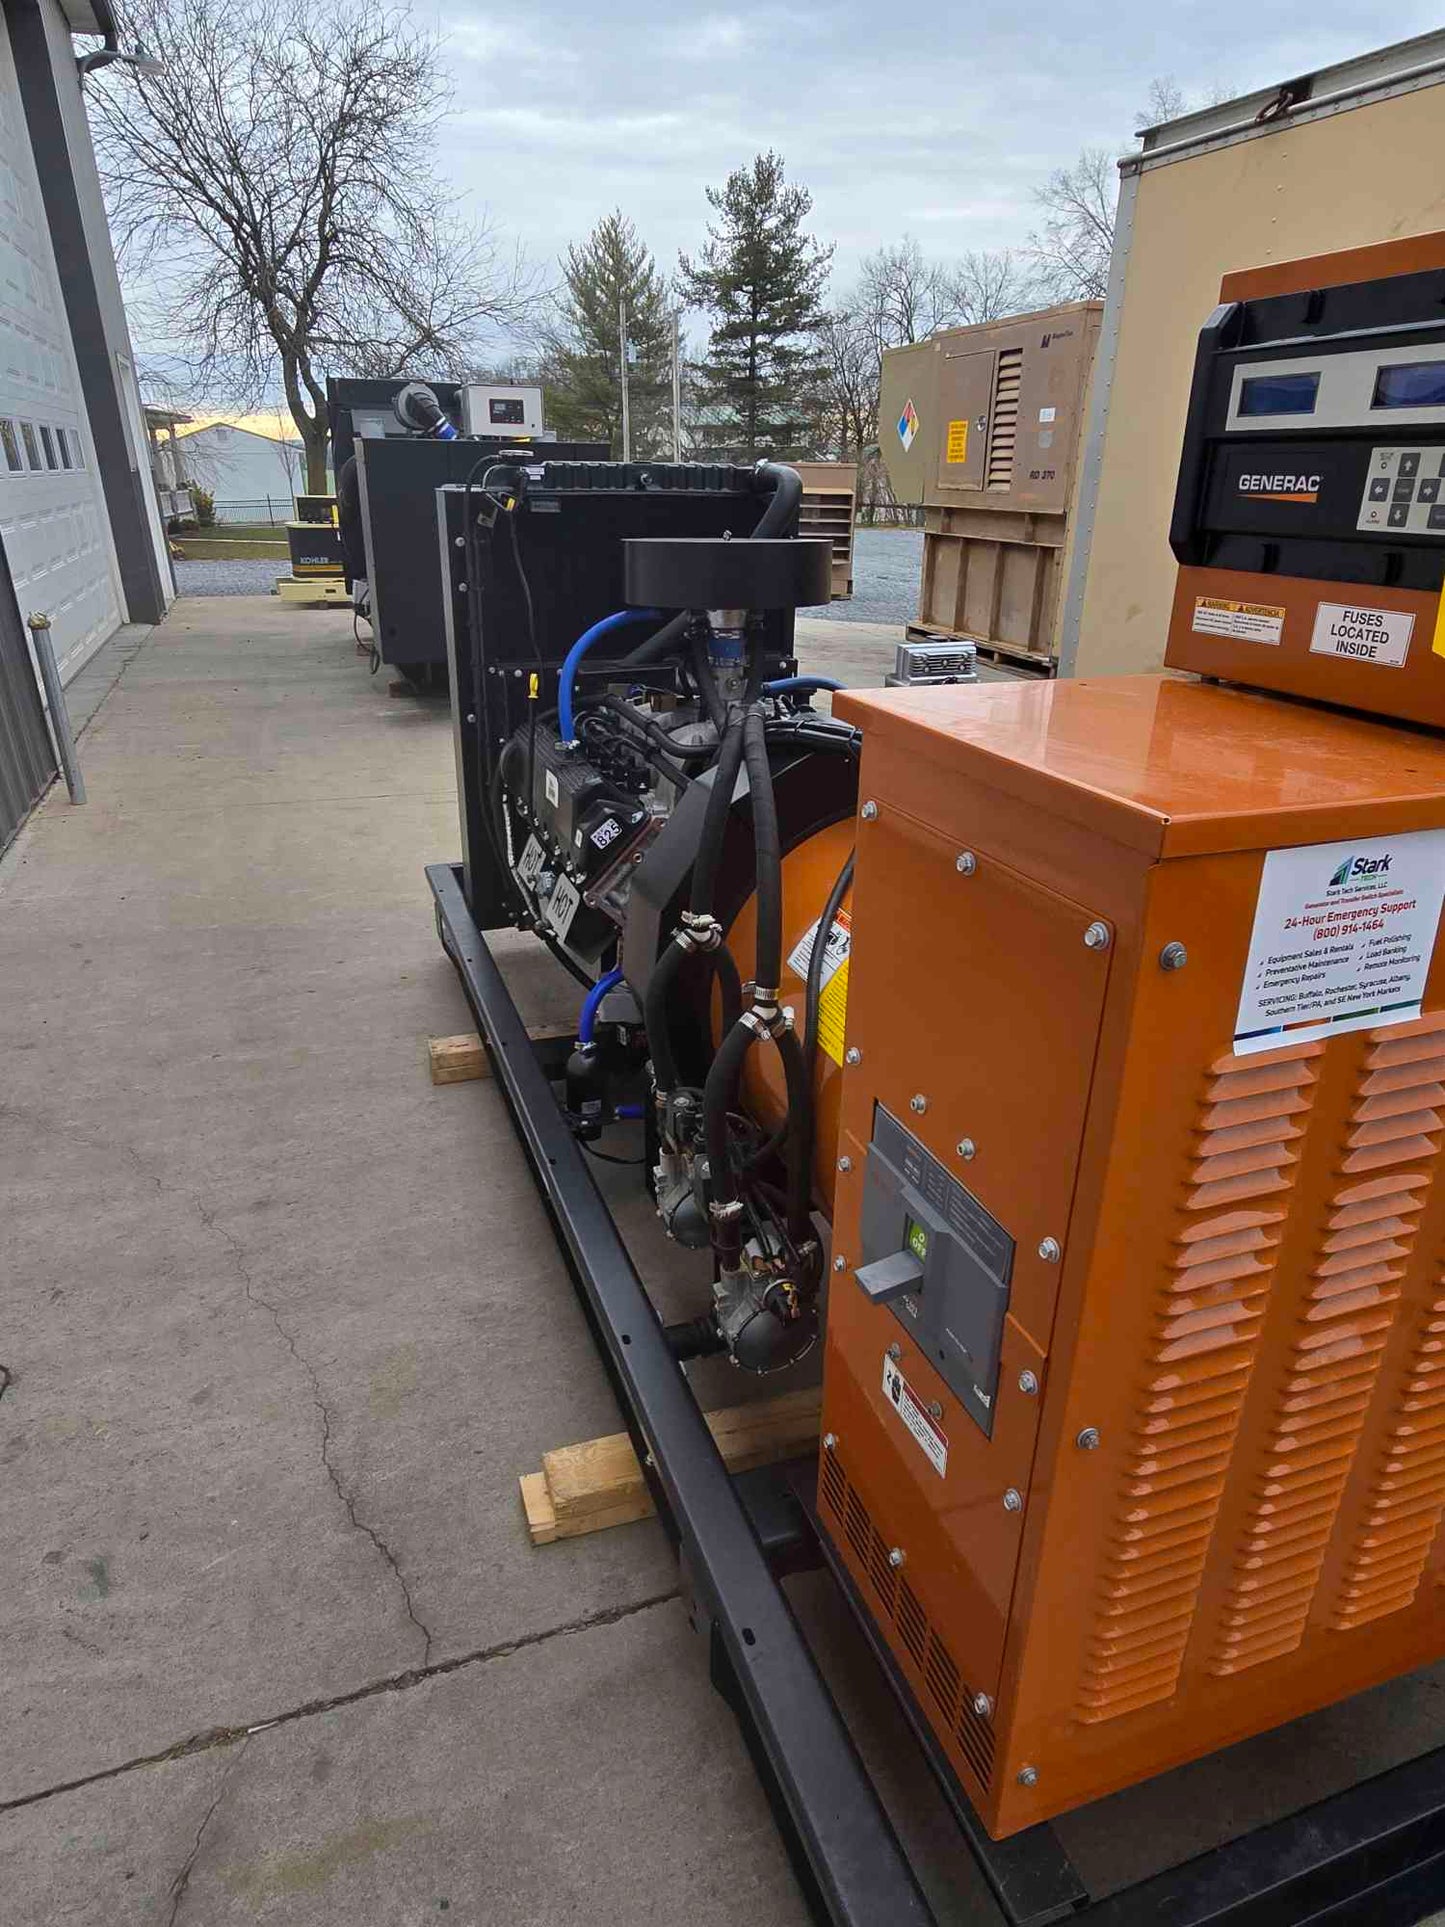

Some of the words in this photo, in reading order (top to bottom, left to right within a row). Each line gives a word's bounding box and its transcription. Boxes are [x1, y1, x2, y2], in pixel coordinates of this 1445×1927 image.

[1238, 474, 1321, 491] GENERAC
[300, 556, 329, 564] KOHLER
[1342, 610, 1384, 627] FUSES
[1330, 623, 1390, 644] LOCATED
[1336, 639, 1378, 658] INSIDE
[597, 823, 620, 846] 825
[1351, 854, 1392, 875] Stark
[1326, 889, 1340, 897] Stark
[552, 886, 573, 925] HOT
[1284, 914, 1326, 929] 24-Hour
[1327, 906, 1379, 923] Emergency
[1380, 899, 1417, 914] Support
[1313, 924, 1340, 941] (800)
[1341, 918, 1384, 935] 914-1464
[1369, 938, 1382, 947] Fuel
[1383, 933, 1412, 944] Polishing
[1268, 952, 1303, 964] Equipment
[1304, 948, 1322, 958] Sales
[1323, 947, 1329, 955] &
[1329, 943, 1354, 954] Rentals
[1364, 961, 1388, 970] Remote
[1388, 954, 1421, 965] Monitoring
[1366, 950, 1382, 959] Load
[1382, 946, 1407, 956] Banking
[1265, 964, 1307, 977] Preventative
[1307, 956, 1350, 968] Maintenance
[1263, 977, 1300, 989] Emergency
[1301, 972, 1326, 983] Repairs
[1265, 1006, 1296, 1017] Southern
[1324, 998, 1337, 1006] and
[1337, 996, 1346, 1004] SE
[1347, 993, 1361, 1002] New
[1362, 990, 1376, 999] York
